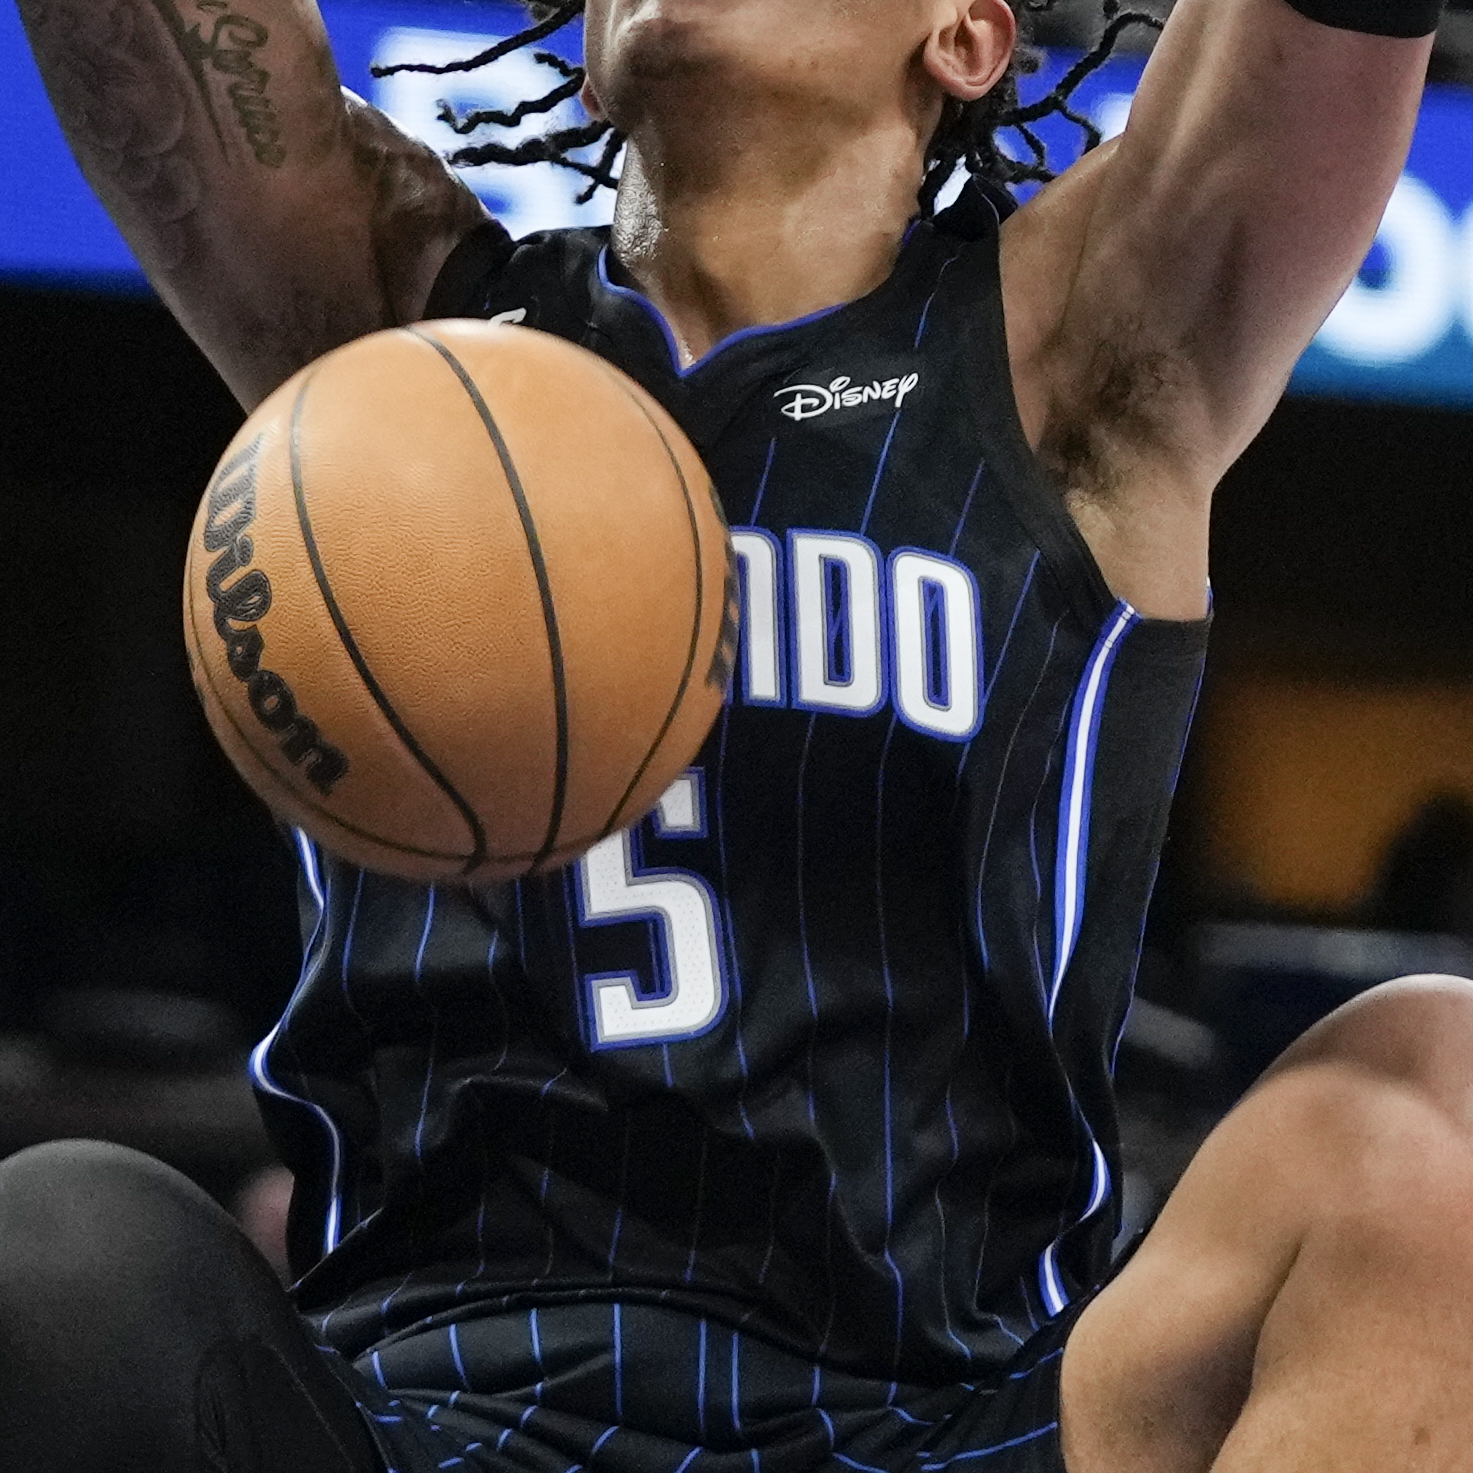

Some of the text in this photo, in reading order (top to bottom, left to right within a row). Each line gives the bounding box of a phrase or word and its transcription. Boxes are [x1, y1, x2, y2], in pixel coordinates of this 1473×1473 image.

[773, 372, 919, 422] Disney
[202, 426, 350, 795] Wilson
[570, 766, 727, 1051] 5
